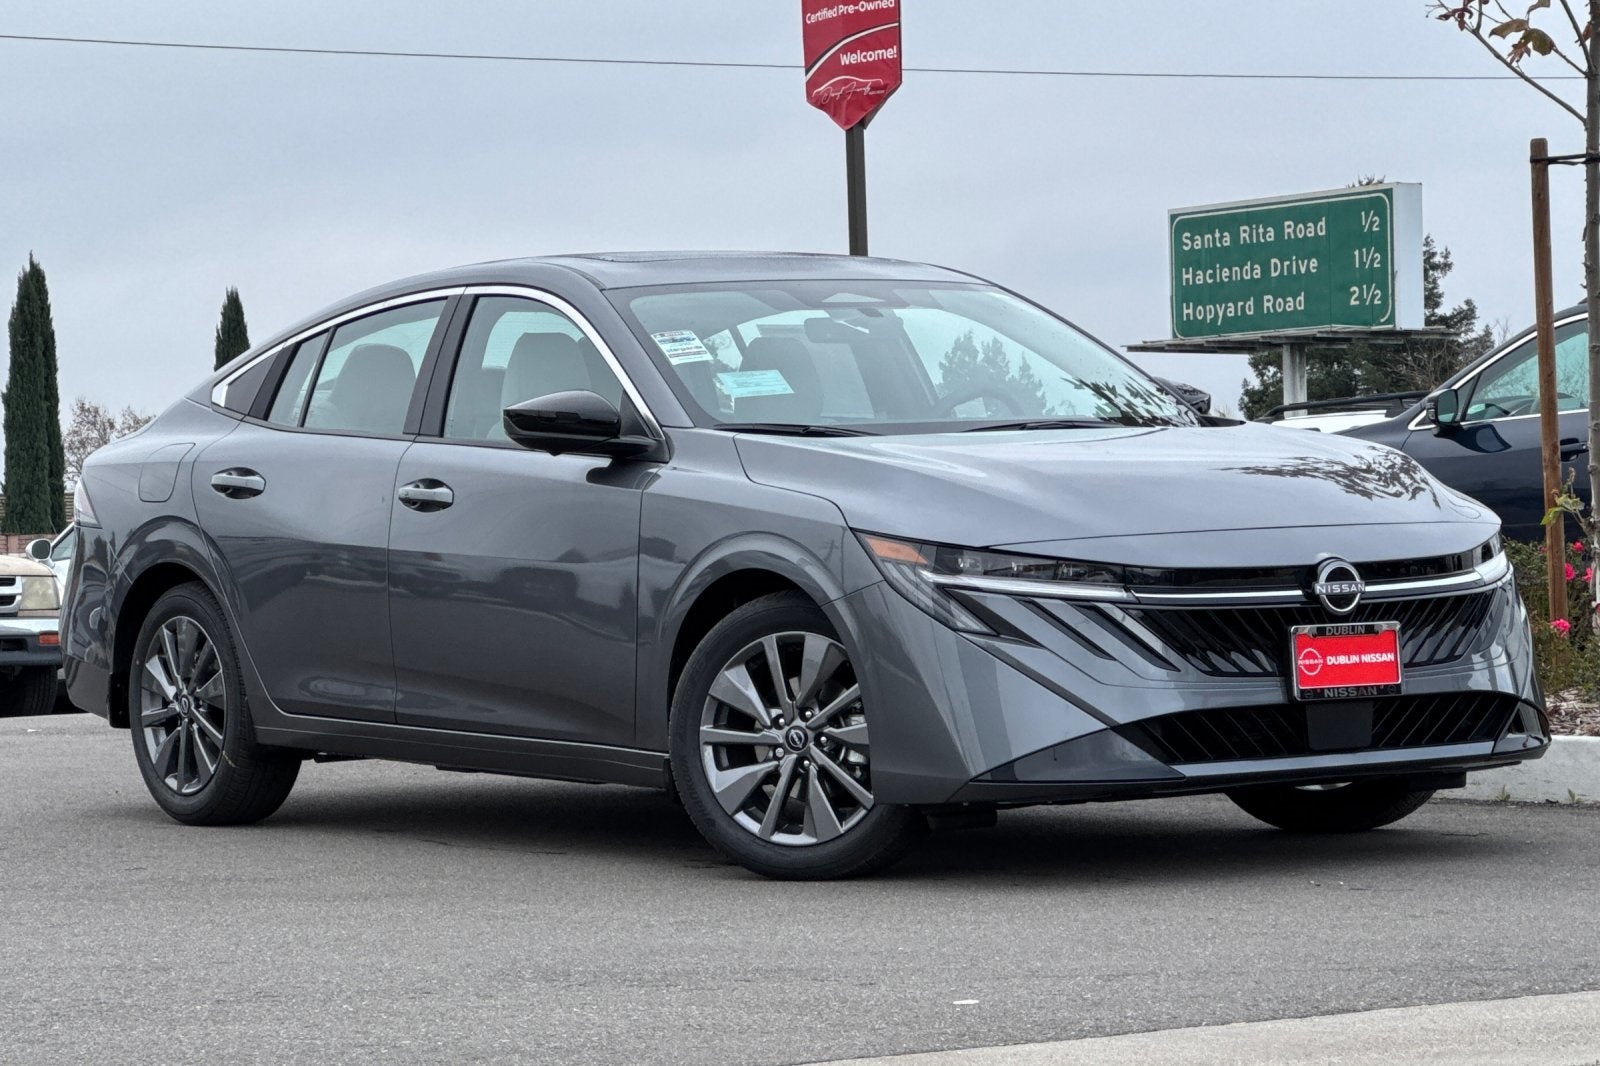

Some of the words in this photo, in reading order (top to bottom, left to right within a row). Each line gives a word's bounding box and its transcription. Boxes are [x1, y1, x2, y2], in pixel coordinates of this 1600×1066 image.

[806, 6, 837, 24] Certified
[838, 0, 895, 15] Pre-Owned
[840, 45, 897, 65] Welcome!
[1182, 228, 1231, 251] Santa
[1240, 224, 1275, 245] Rita
[1284, 216, 1326, 240] Road
[1182, 260, 1261, 286] Hacienda
[1270, 256, 1318, 278] Drive
[1182, 297, 1254, 326] Hopyard
[1263, 292, 1305, 314] Road
[1315, 583, 1365, 594] NISSAN
[1325, 625, 1366, 636] DUBLIN
[1326, 655, 1360, 665] DUBLIN
[1361, 653, 1395, 663] NISSAN
[1324, 686, 1377, 698] NISSAN
